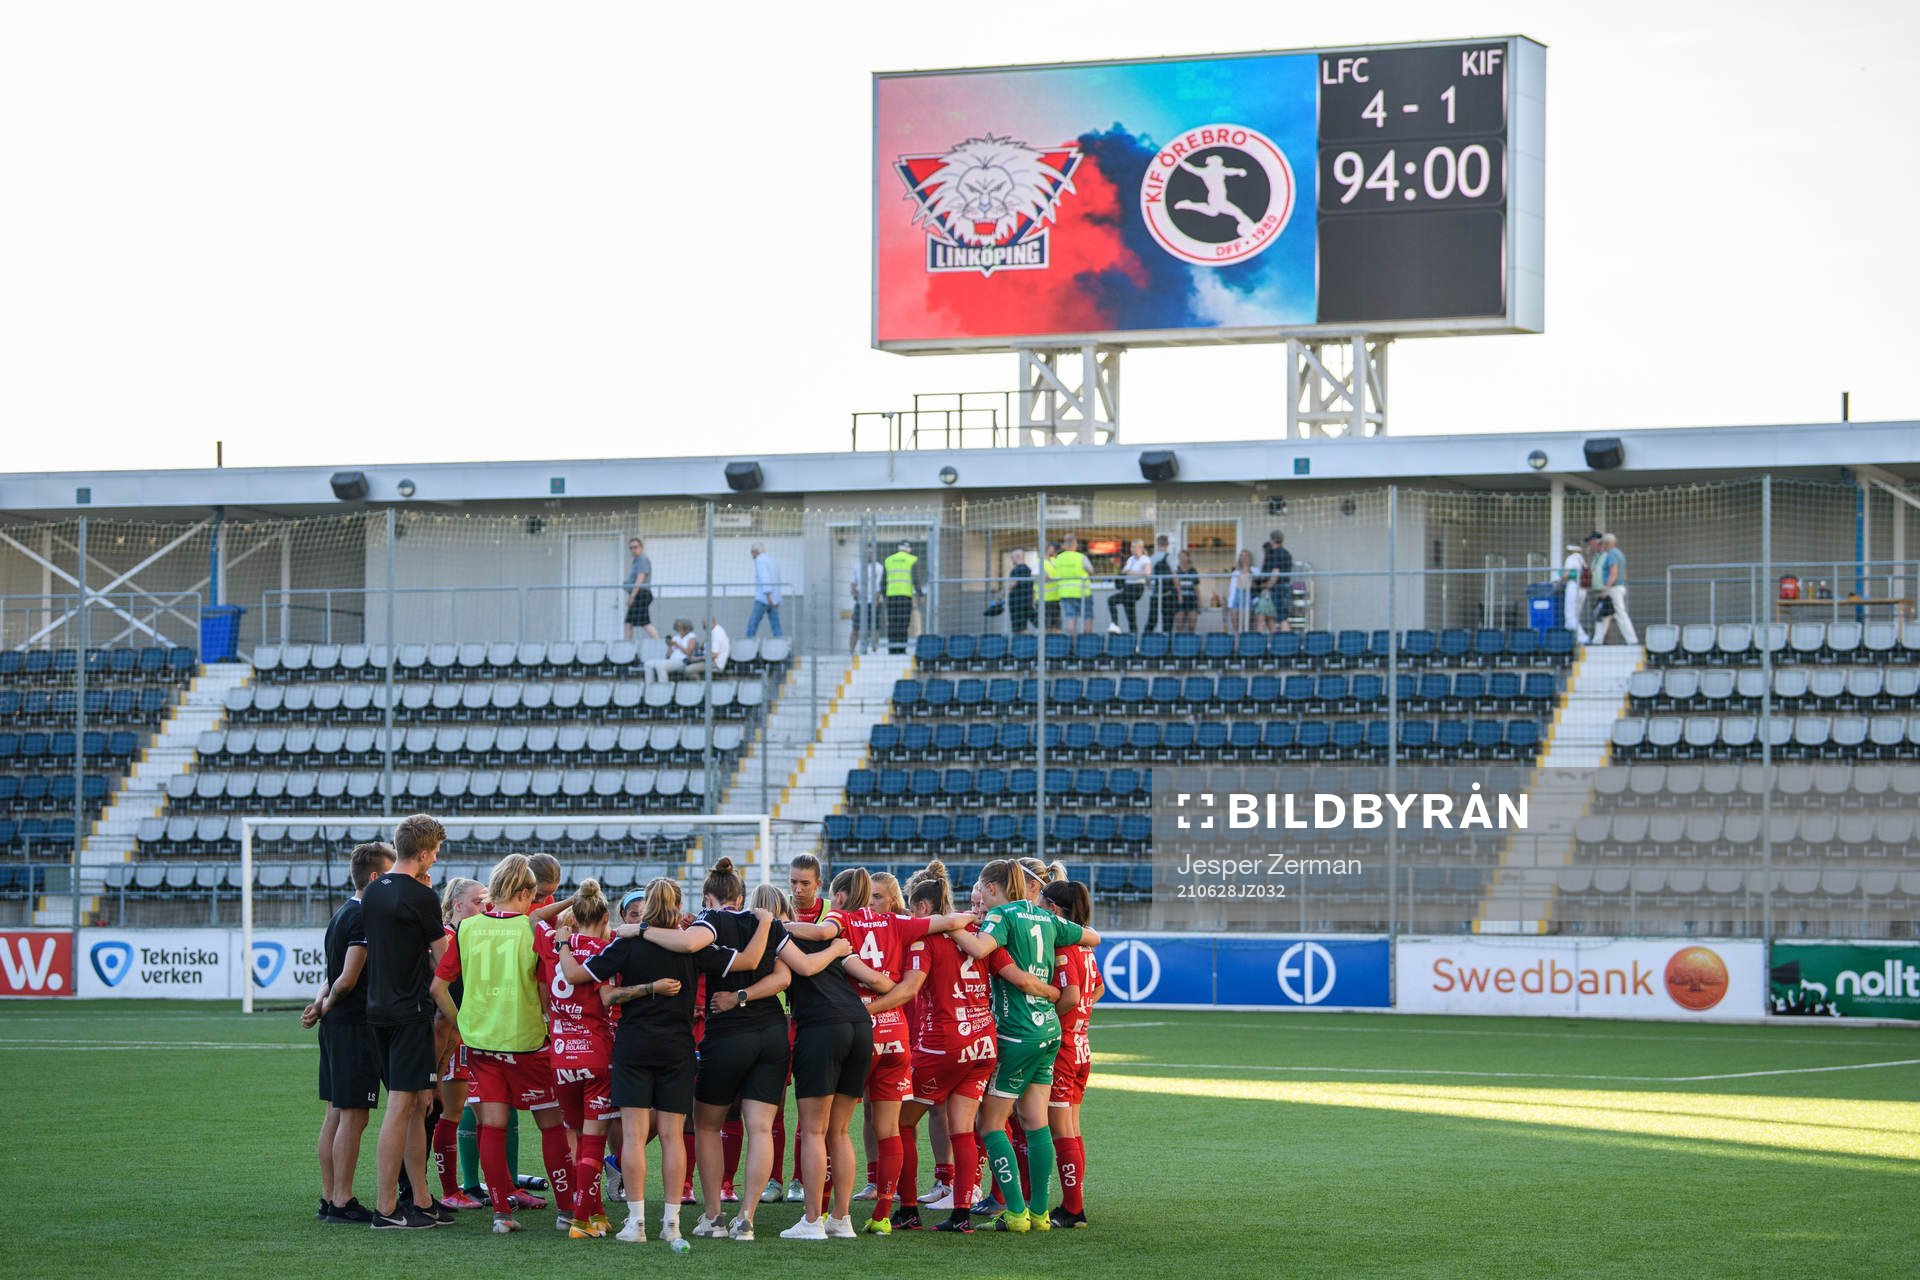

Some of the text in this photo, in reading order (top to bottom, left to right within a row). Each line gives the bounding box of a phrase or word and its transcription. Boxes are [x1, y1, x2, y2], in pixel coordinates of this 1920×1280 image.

[1322, 49, 1504, 85] LFC KIF
[1361, 89, 1388, 128] 4
[1440, 85, 1456, 124] 1
[1144, 128, 1248, 203] KIF ÖREBRO
[1333, 143, 1491, 204] 94:00
[935, 241, 1041, 267] LINKÖPING
[140, 947, 219, 965] Tekniska
[292, 948, 329, 965] Tek
[471, 939, 516, 981] 11
[859, 930, 884, 968] 4
[1030, 924, 1044, 963] 1
[141, 967, 202, 984] verken
[293, 968, 329, 984] ver
[551, 960, 575, 999] 8
[961, 955, 980, 979] 2
[1431, 957, 1655, 995] Swedbank
[1835, 959, 1920, 998] nollt
